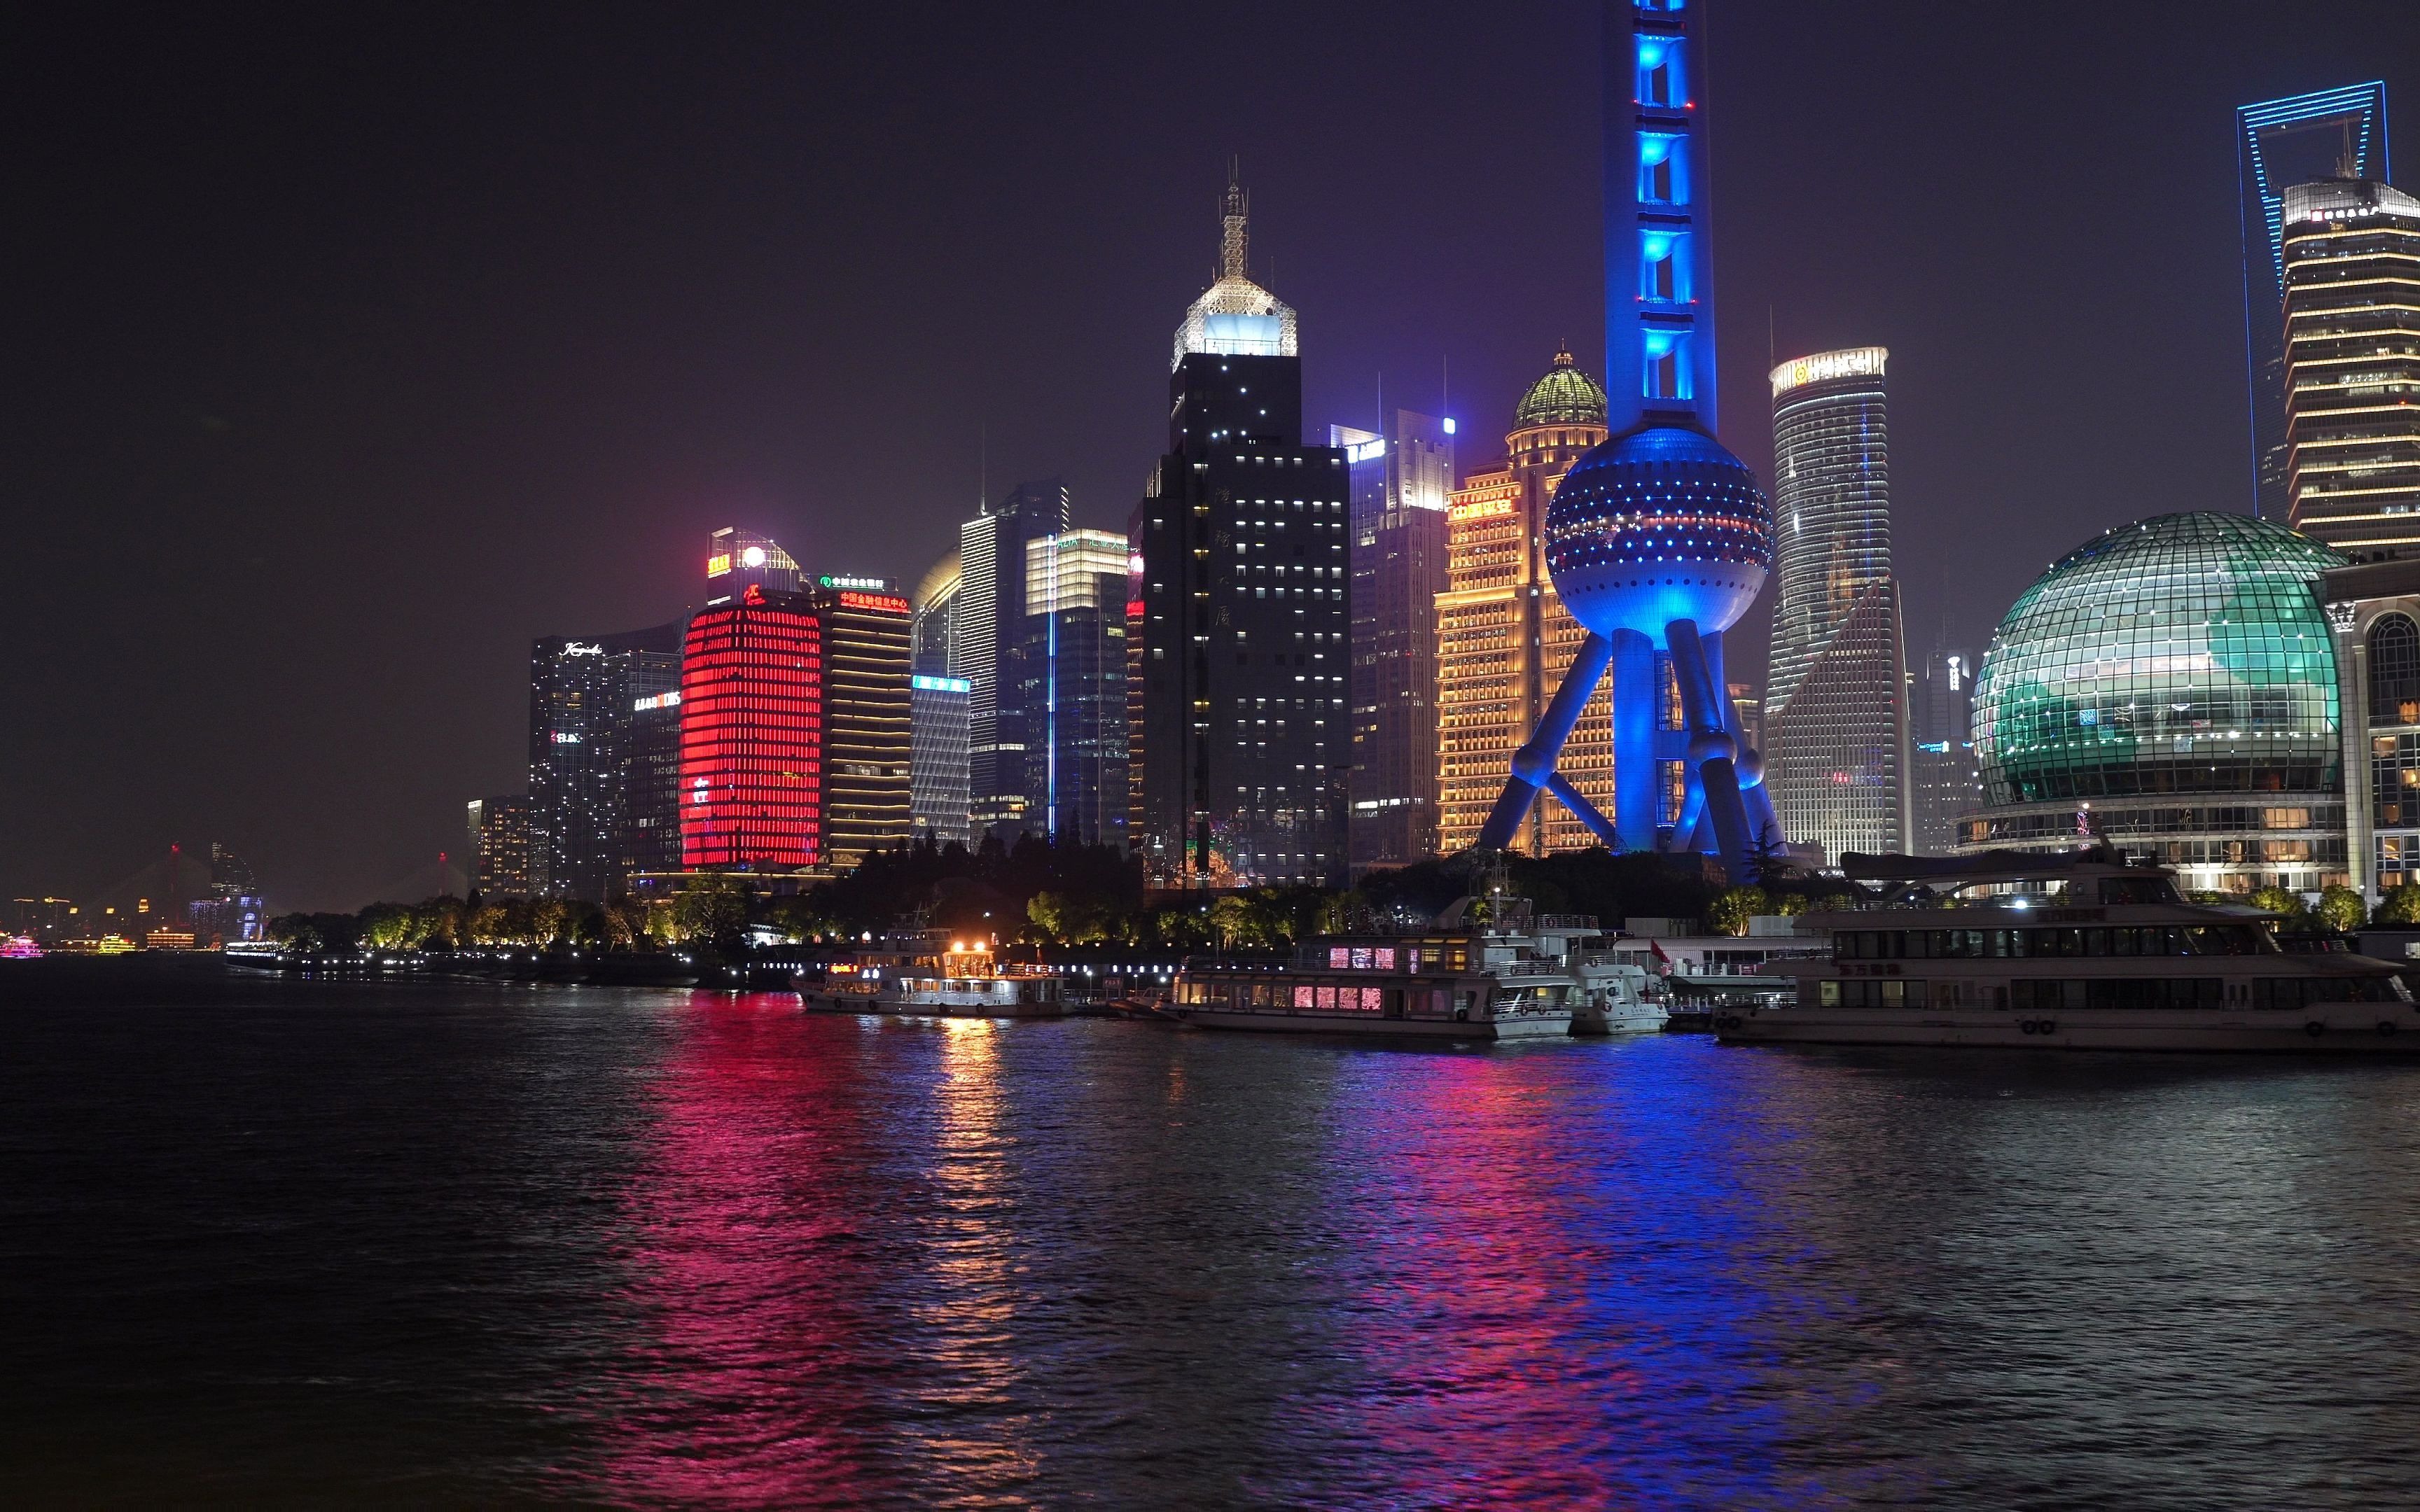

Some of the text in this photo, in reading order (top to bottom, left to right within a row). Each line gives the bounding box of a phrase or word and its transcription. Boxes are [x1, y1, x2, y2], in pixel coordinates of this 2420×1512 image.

[1453, 498, 1512, 519] 中国平安
[841, 592, 908, 608] 中国金融信息中心
